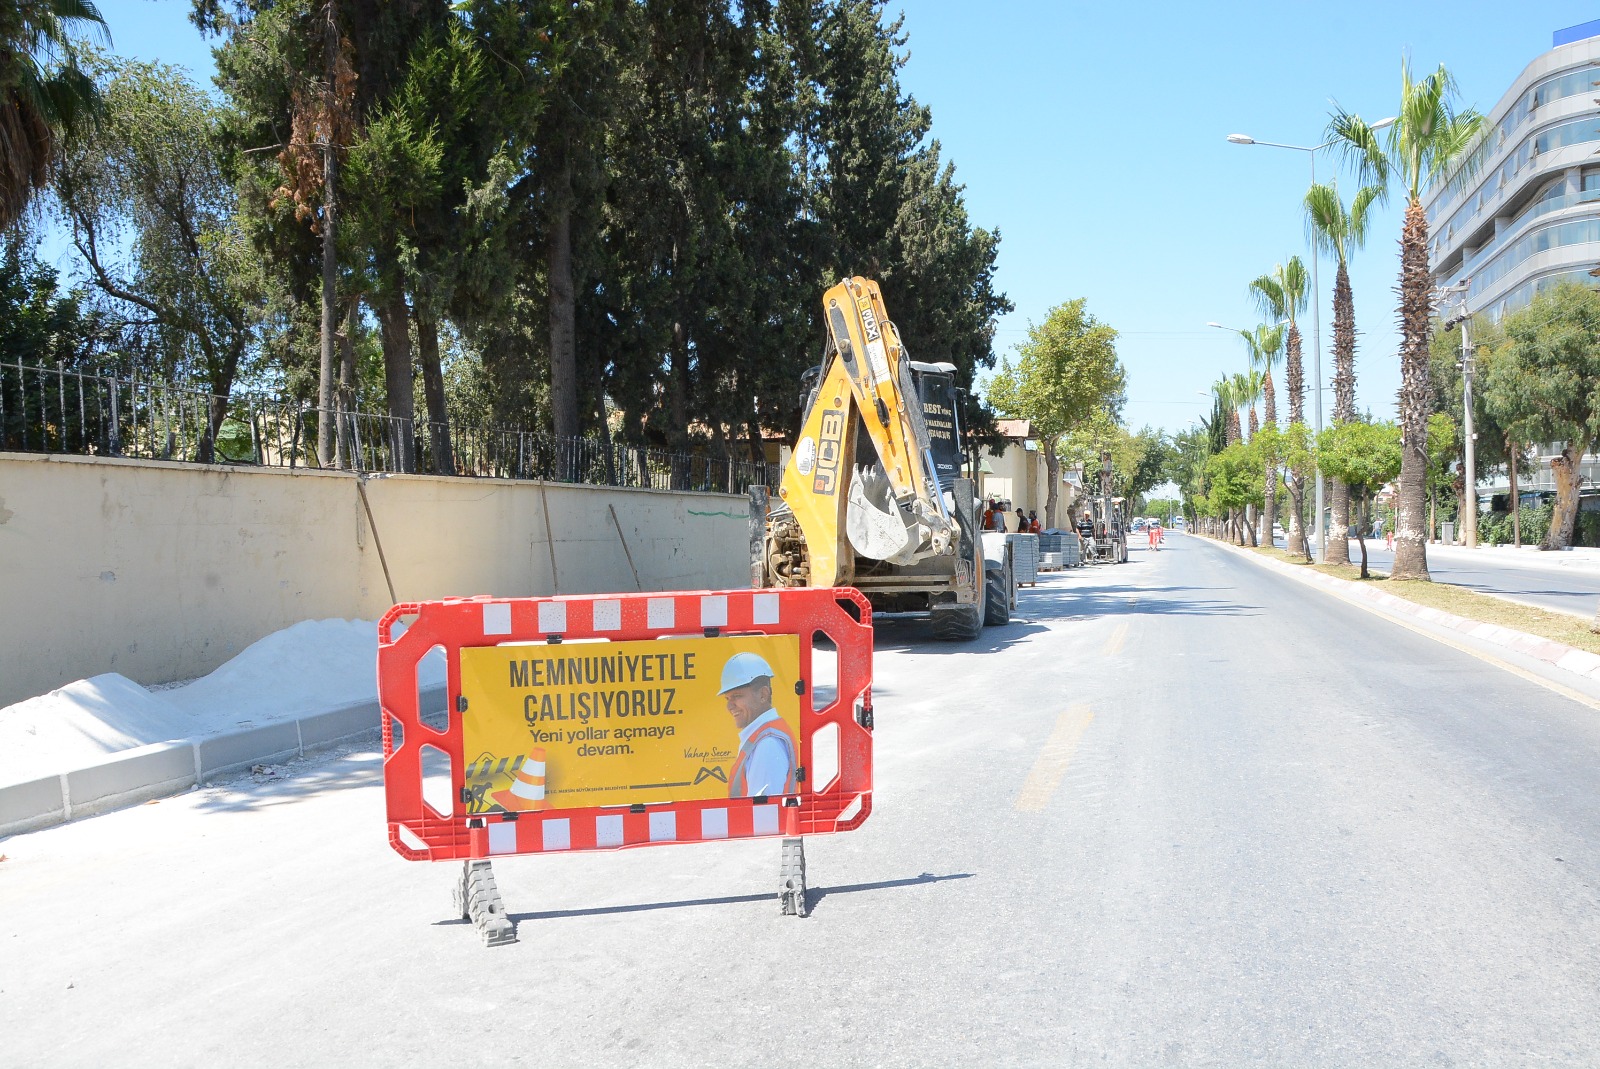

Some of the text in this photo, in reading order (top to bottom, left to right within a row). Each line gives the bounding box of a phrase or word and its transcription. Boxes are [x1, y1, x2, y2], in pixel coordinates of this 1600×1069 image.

[923, 403, 941, 414] BEST
[816, 414, 842, 492] JCB
[509, 651, 696, 688] MEMNUNİYETLE
[523, 688, 684, 727] ÇALIŞIYORUZ.
[530, 725, 675, 744] Yeni yollar açmaya
[577, 743, 635, 757] devam.
[684, 746, 710, 762] Vahap
